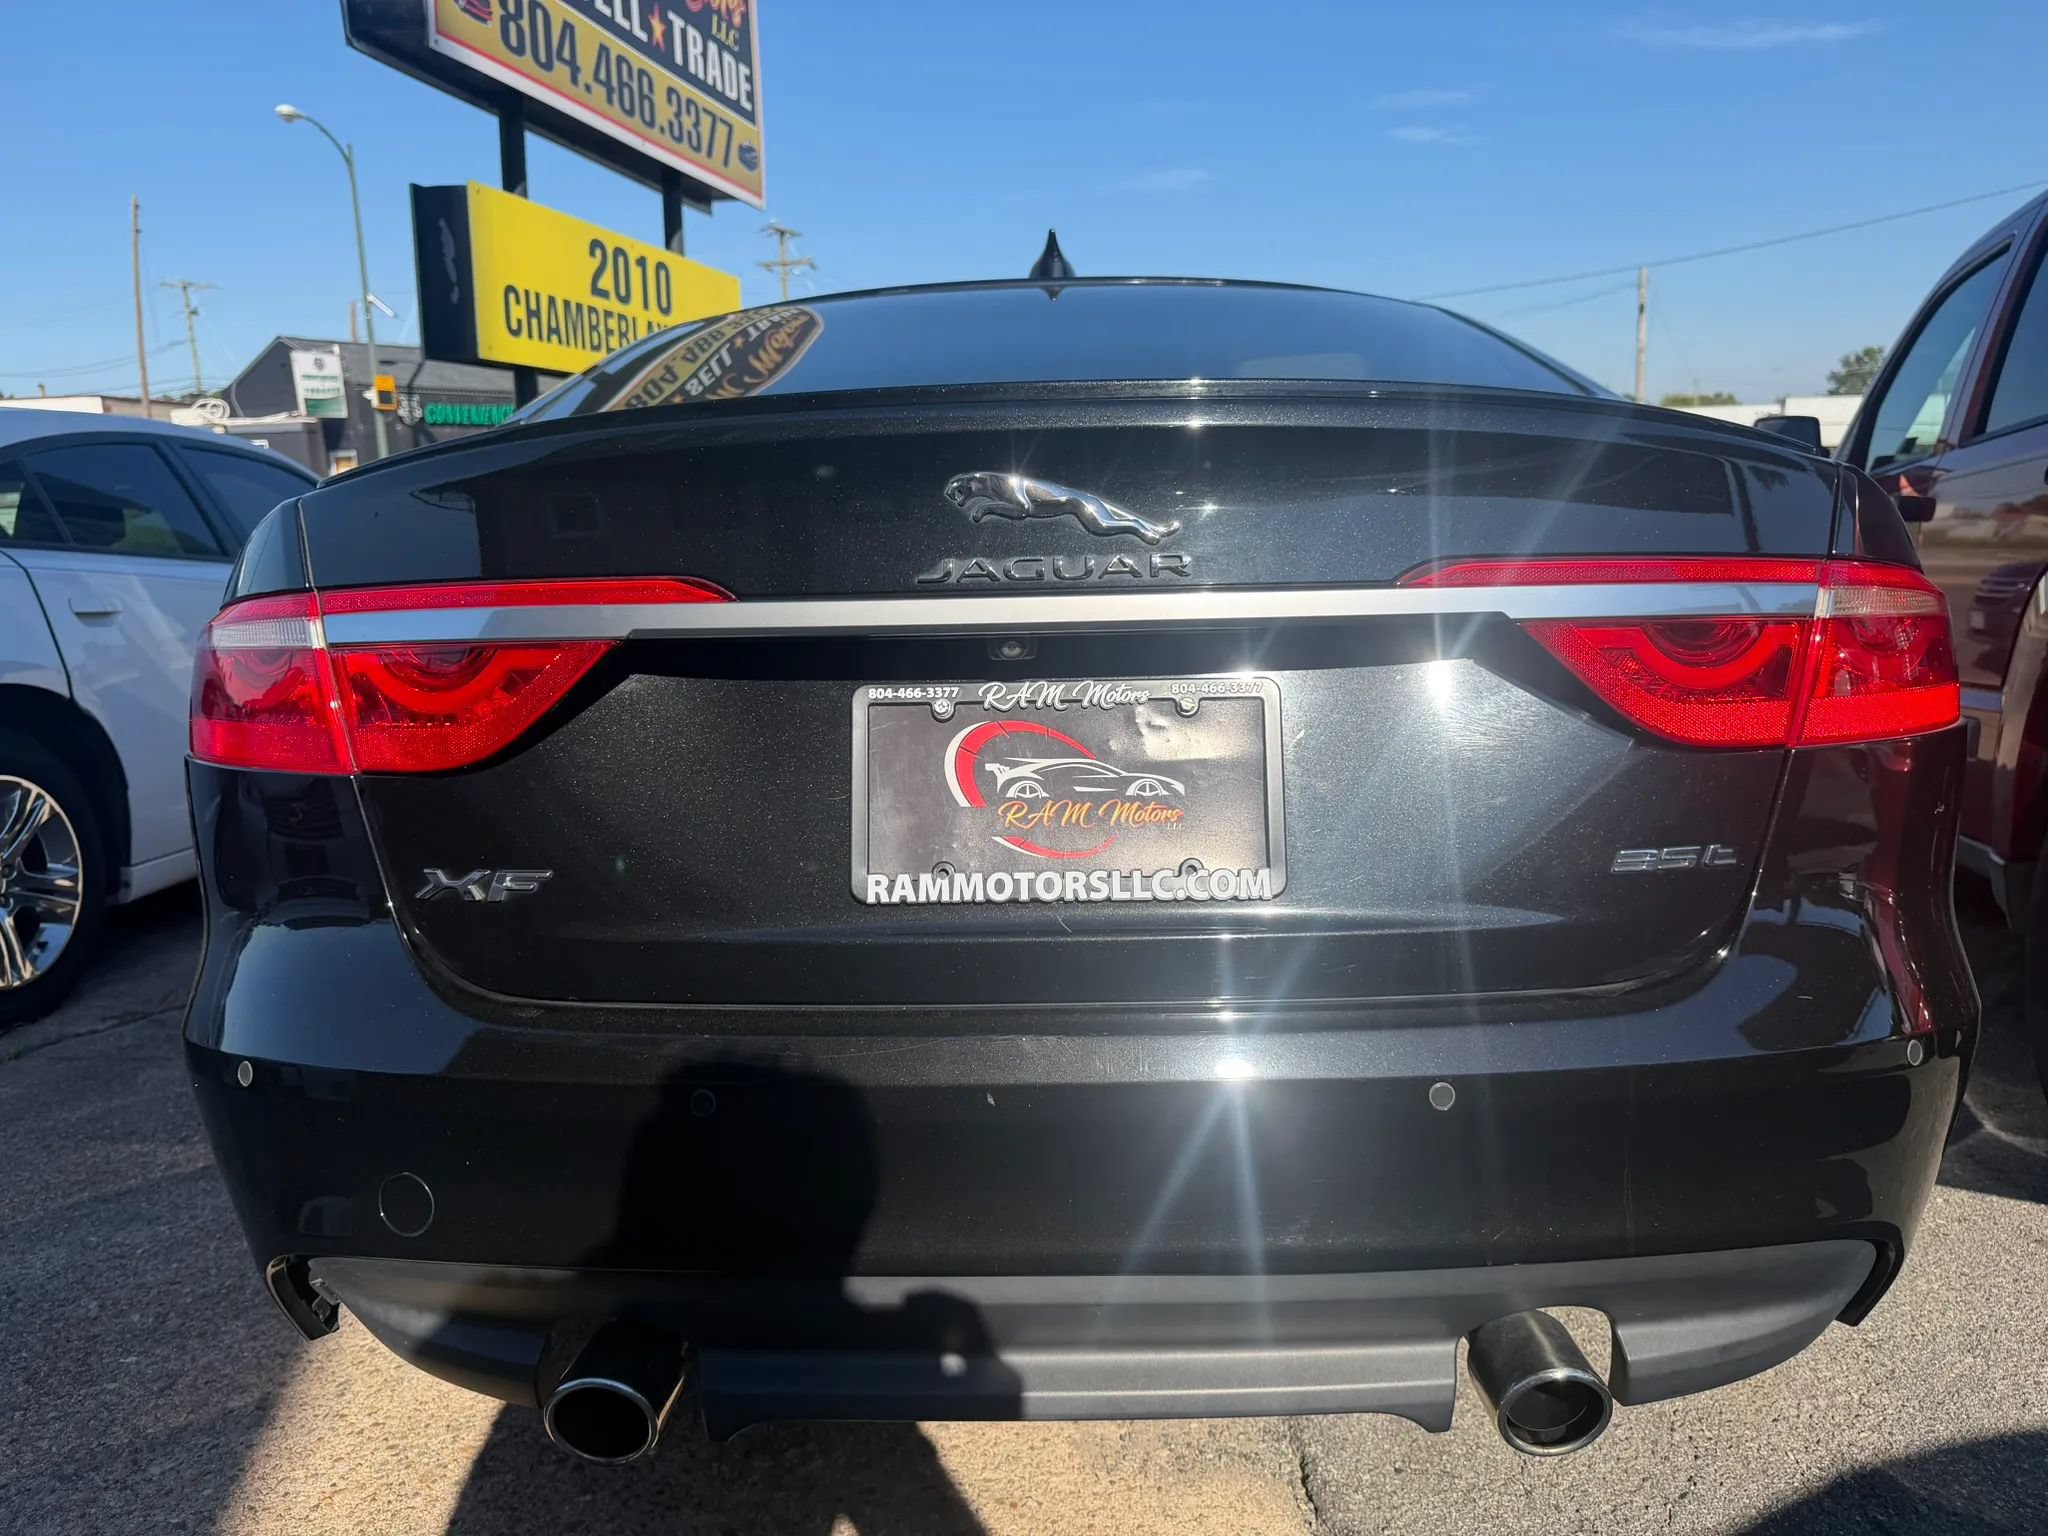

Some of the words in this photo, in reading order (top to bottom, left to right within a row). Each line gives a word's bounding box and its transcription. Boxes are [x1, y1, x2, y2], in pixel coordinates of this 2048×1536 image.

[712, 14, 740, 52] LLC
[666, 9, 753, 112] TRADE
[499, 0, 734, 169] 804.466.3377
[588, 238, 672, 317] 2010
[917, 552, 1193, 585] JAGUAR
[868, 686, 960, 700] 804-466-3377
[977, 681, 1069, 712] RAM
[1072, 680, 1152, 709] Motors
[1170, 682, 1264, 695] 804-466-3377
[998, 799, 1094, 830] RAM
[1098, 799, 1185, 828] Motors
[415, 868, 553, 902] XF
[867, 868, 1273, 905] RAMMOTORSLLC.COM
